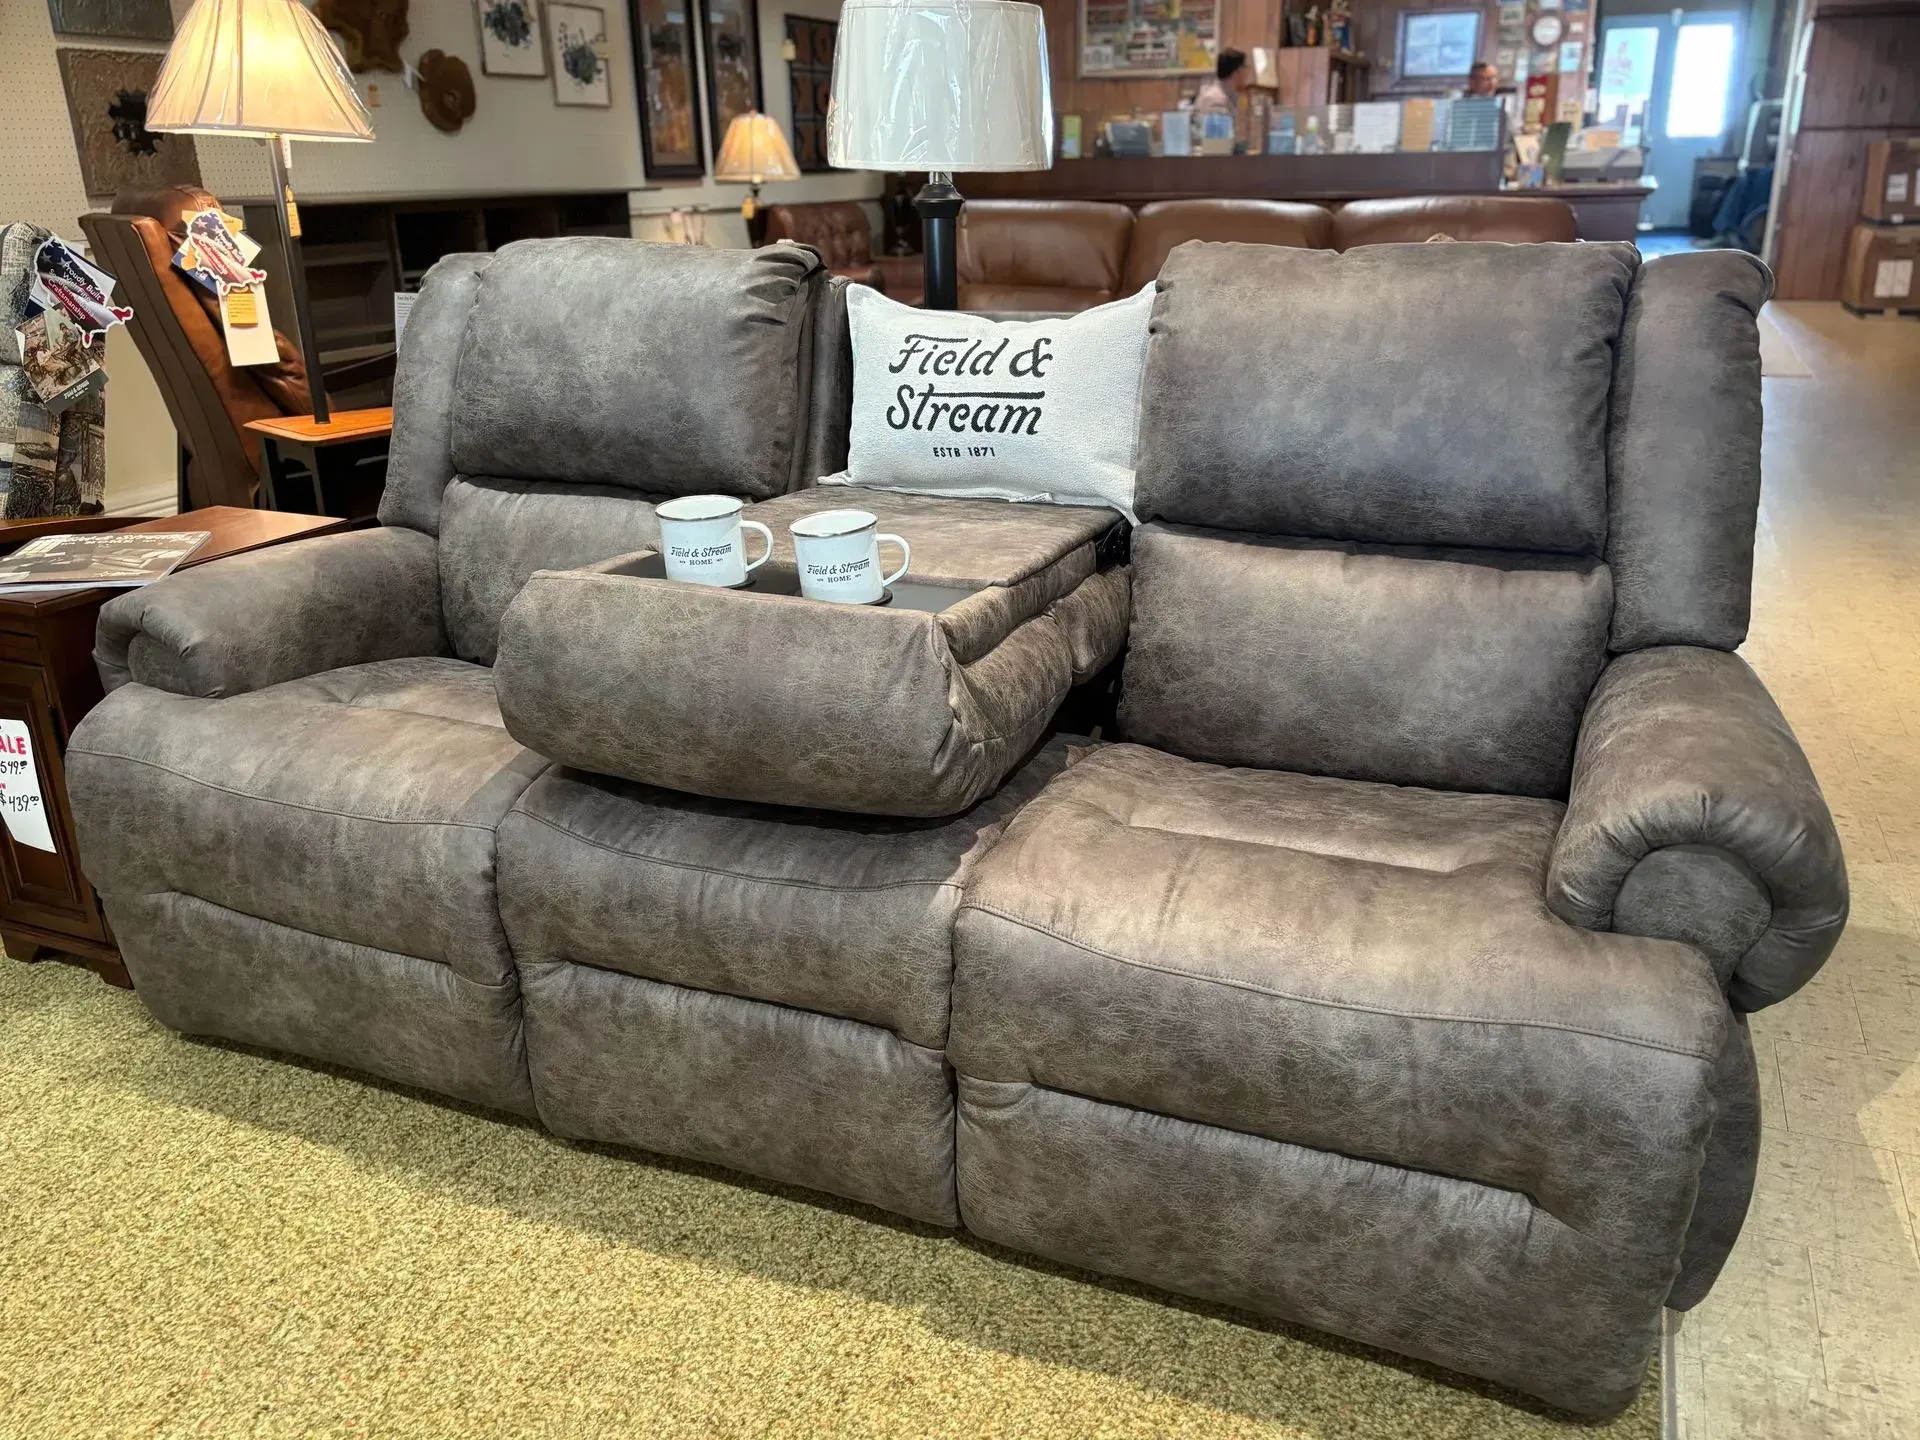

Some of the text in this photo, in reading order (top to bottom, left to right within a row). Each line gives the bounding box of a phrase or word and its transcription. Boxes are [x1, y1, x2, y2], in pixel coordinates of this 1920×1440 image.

[63, 262, 102, 301] Proudly Built
[48, 279, 86, 320] Craftsmanship
[888, 333, 1053, 378] Field &
[886, 383, 1046, 435] Stream
[933, 446, 995, 458] ESTB 1871
[671, 543, 732, 558] Field & Stream
[807, 558, 870, 575] Field & Stream
[827, 575, 851, 583] HOME
[0, 734, 26, 755] ALE
